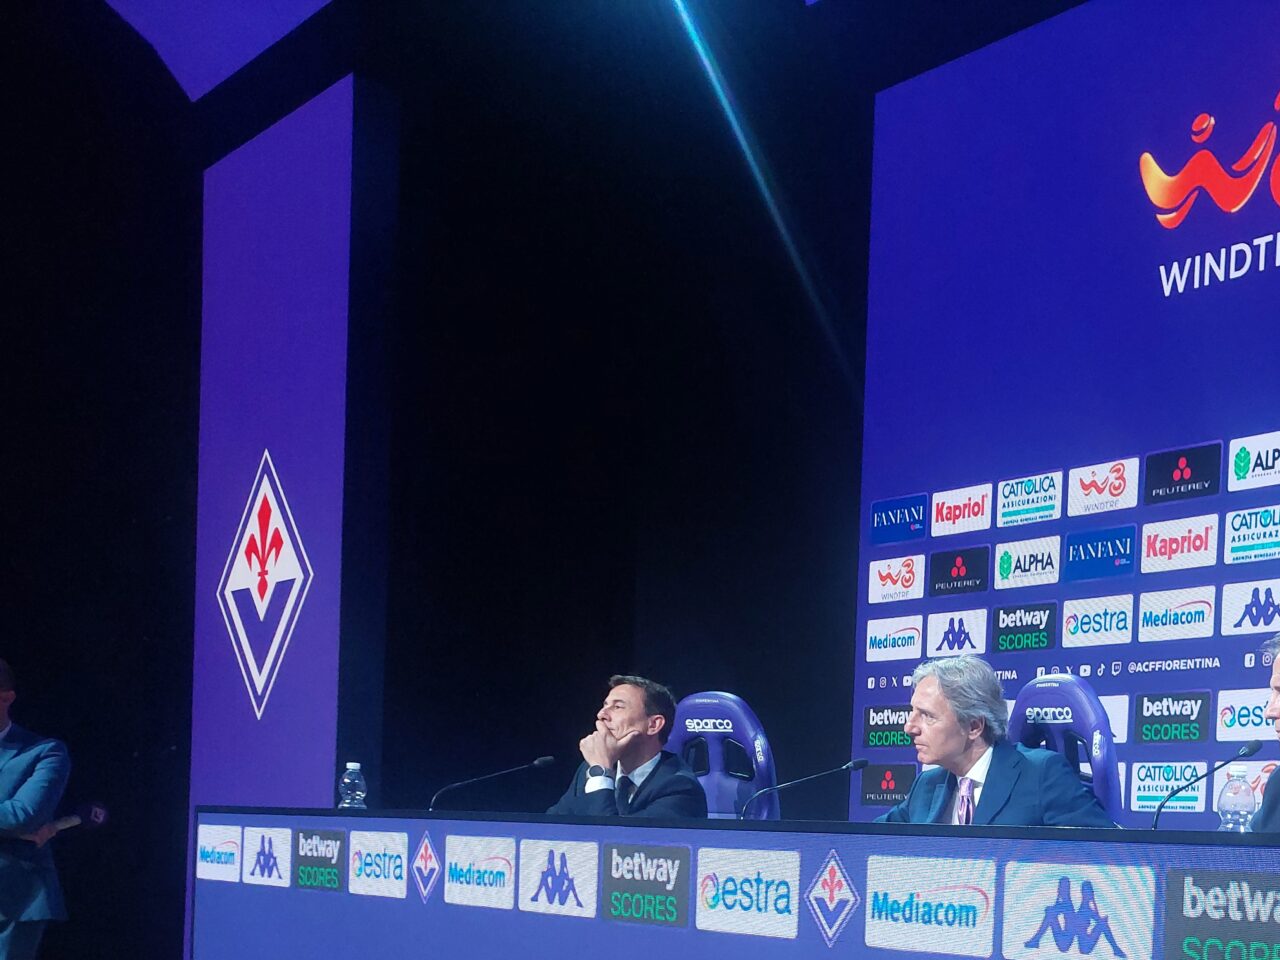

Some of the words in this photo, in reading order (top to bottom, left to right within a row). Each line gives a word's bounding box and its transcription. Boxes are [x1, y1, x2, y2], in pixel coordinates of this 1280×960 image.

[1002, 476, 1056, 499] CATTOLICA
[1152, 480, 1211, 496] PEUTEREY
[1002, 495, 1056, 508] ASSICURAZIONI
[1084, 499, 1119, 511] WINDTRE
[874, 505, 923, 527] FANFANI
[1069, 539, 1130, 562] FANFANI
[1013, 551, 1054, 571] ALPHA
[935, 579, 981, 590] PEUTEREY
[881, 591, 909, 600] WINDTRE
[999, 609, 1049, 628] betway
[1079, 608, 1128, 633] estra
[1142, 607, 1205, 628] Mediacom
[869, 631, 915, 650] Mediacom
[999, 632, 1048, 650] SCORES
[1128, 657, 1220, 674] @ACFFIORENTINA
[1025, 706, 1073, 723] sparco
[1142, 697, 1202, 719] betway
[685, 718, 733, 732] sparco
[1142, 724, 1199, 741] SCORES
[869, 731, 911, 745] SCORES
[1137, 765, 1199, 781] CATTOLICA
[200, 844, 237, 866] Mediacom
[298, 833, 340, 863] betway
[361, 849, 404, 882] estra
[448, 861, 505, 888] Mediacom
[611, 849, 681, 890] betway
[299, 864, 339, 889] SCORES
[718, 871, 792, 915] estra
[610, 892, 677, 922] SCORES
[871, 890, 977, 928] Mediacom
